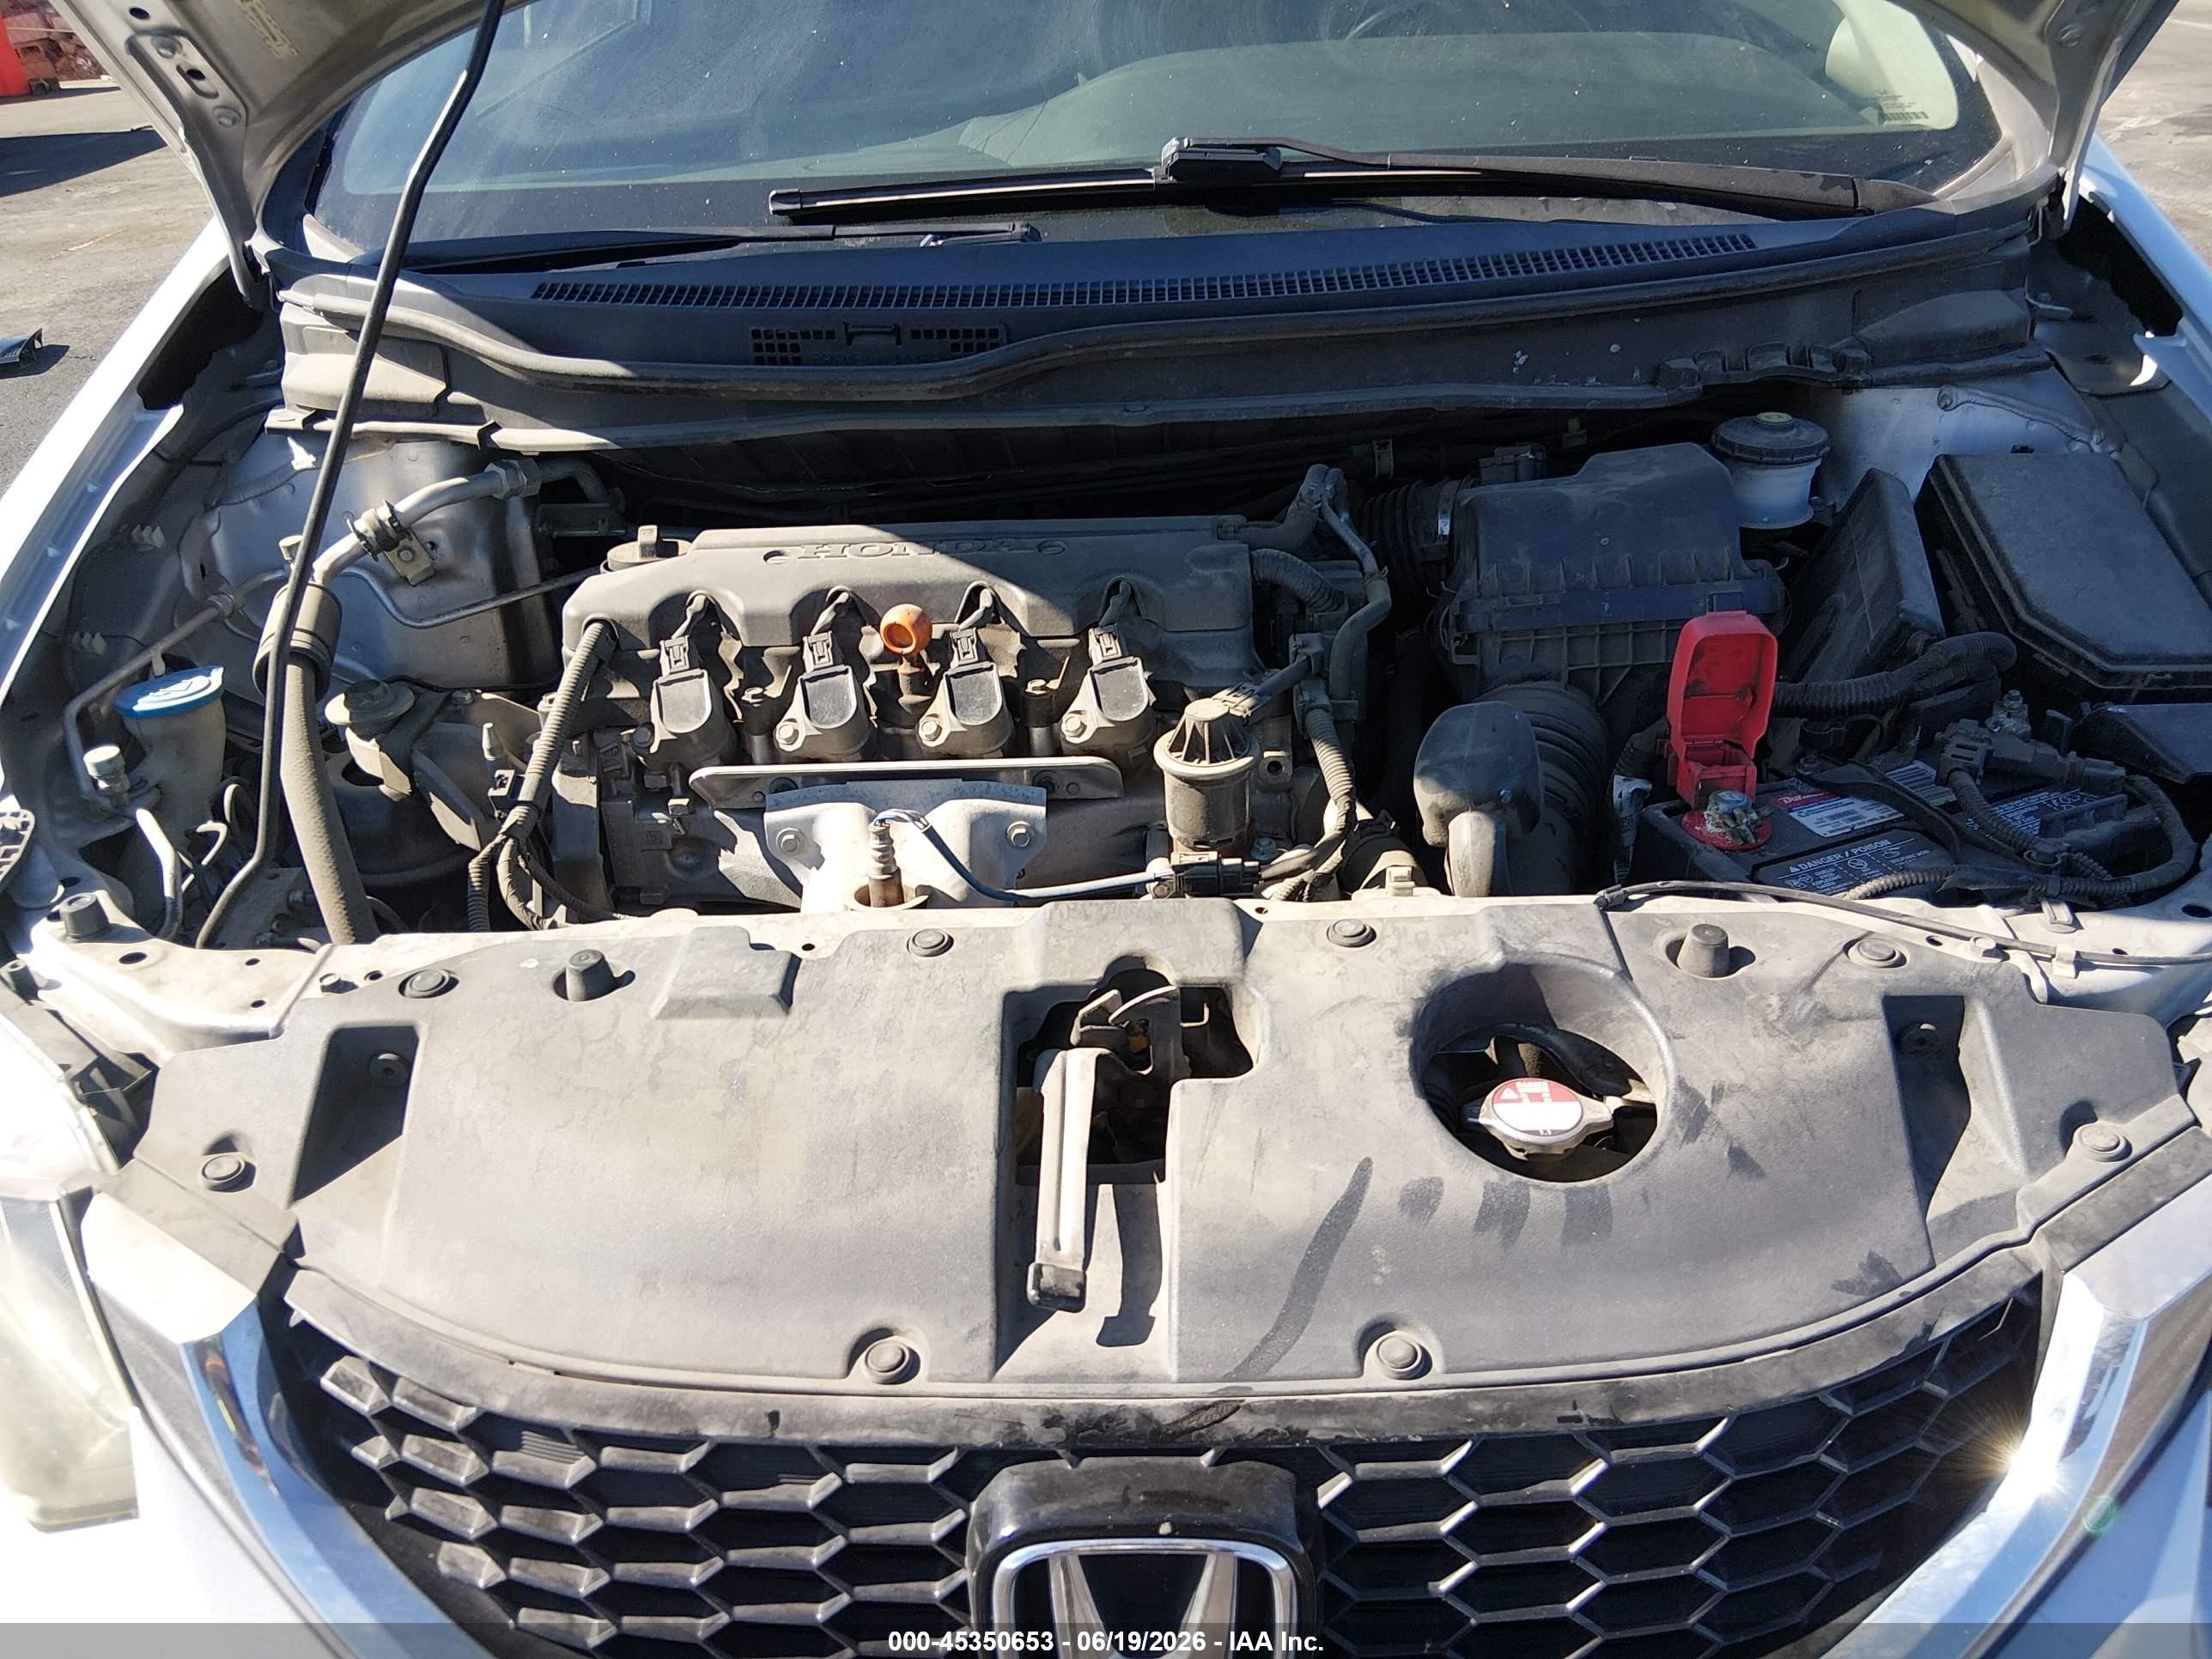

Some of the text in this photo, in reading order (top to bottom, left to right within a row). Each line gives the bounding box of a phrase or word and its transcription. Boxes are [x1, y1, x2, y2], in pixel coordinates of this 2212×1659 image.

[797, 538, 1033, 558] HONDA
[1798, 853, 1844, 870] DANGER
[1850, 839, 1892, 855] POISON
